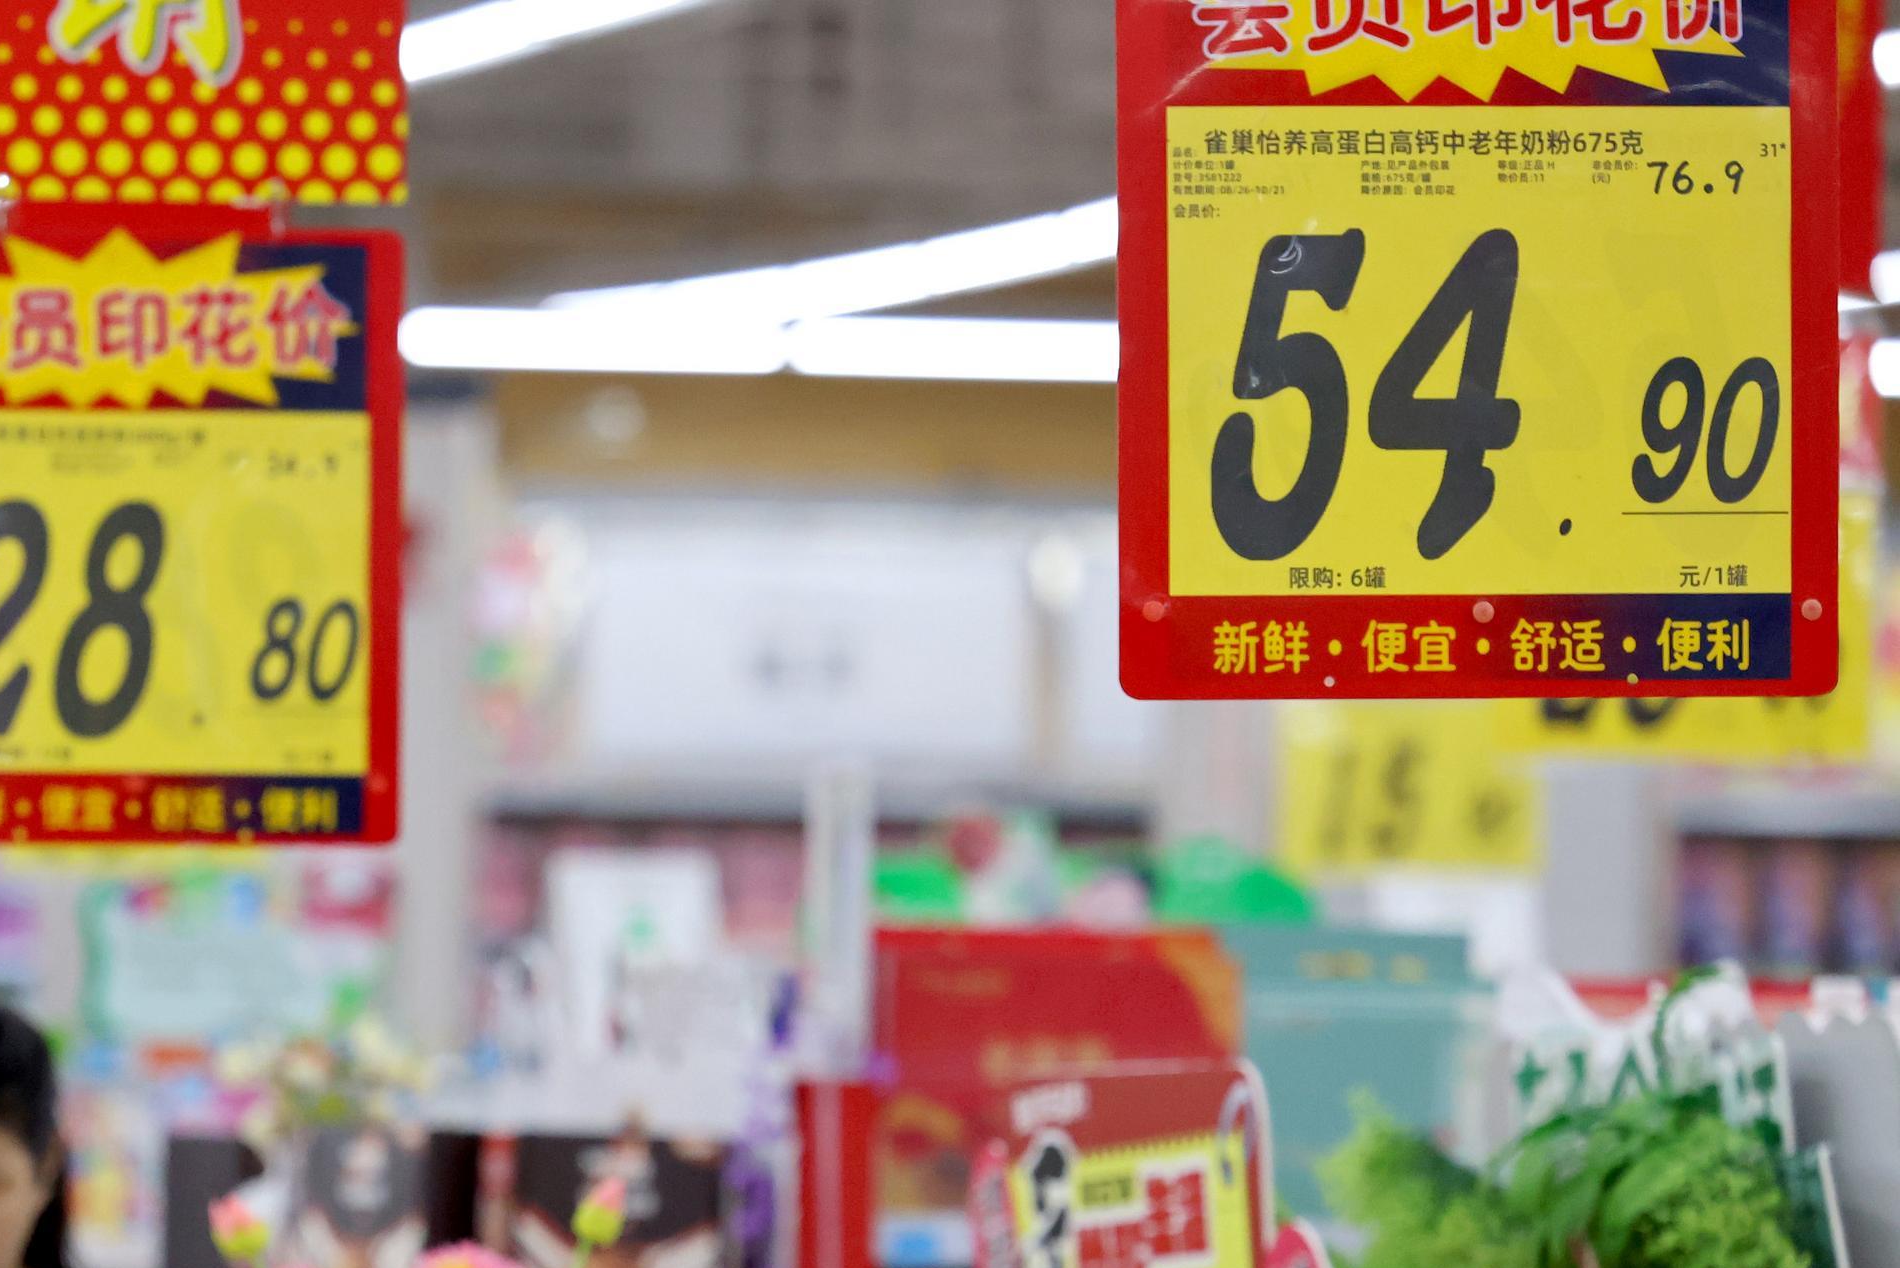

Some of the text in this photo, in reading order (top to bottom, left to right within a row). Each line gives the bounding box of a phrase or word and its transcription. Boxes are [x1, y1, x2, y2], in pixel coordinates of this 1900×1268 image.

[1203, 129, 1644, 156] 雀巢怡养高蛋白高钙中老年奶粉675克
[1647, 161, 1745, 194] 76.9
[1173, 204, 1221, 218] 会员价:
[1678, 565, 1749, 588] 元/1罐
